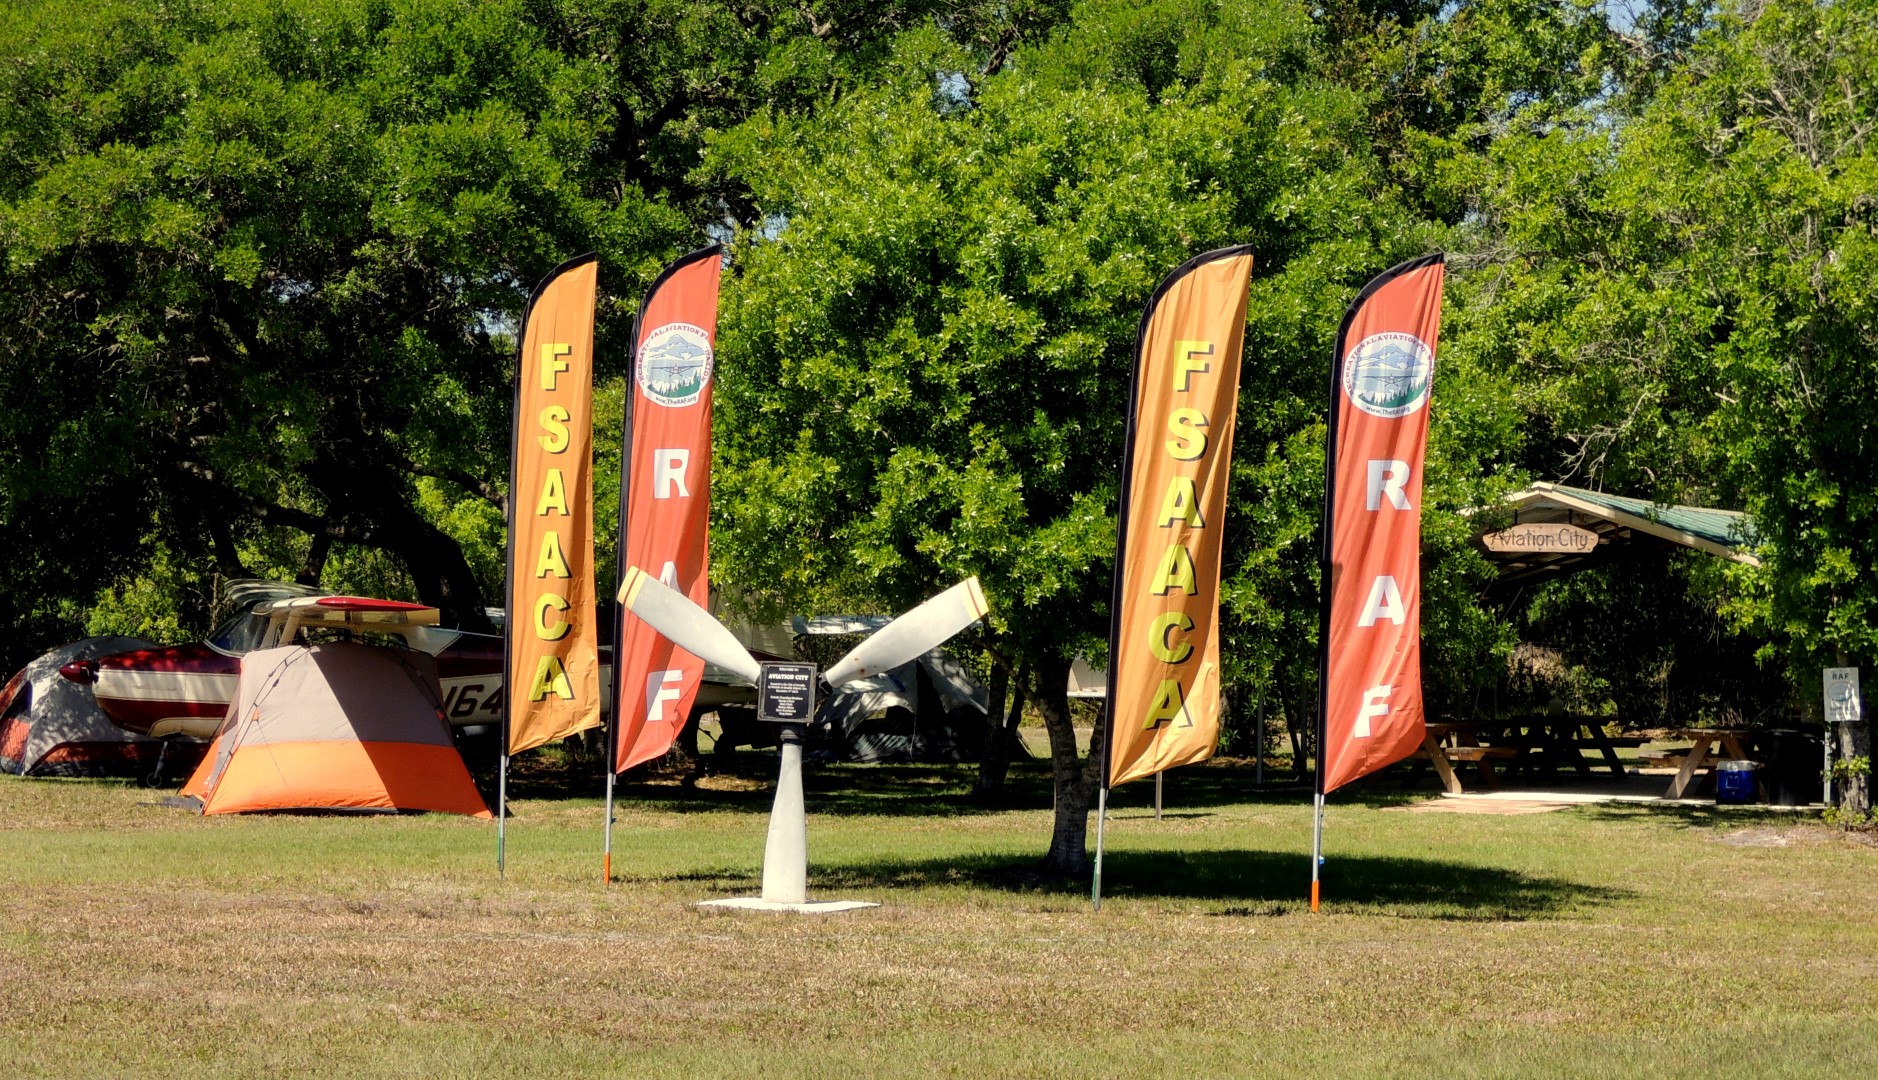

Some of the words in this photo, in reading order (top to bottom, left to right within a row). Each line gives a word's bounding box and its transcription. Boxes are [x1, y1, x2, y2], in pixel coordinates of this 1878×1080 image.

[528, 342, 576, 702] FSAACA
[1142, 340, 1214, 730] FSAACA
[1354, 459, 1413, 738] RAF
[1489, 529, 1554, 546] Aviation
[1559, 528, 1588, 550] City
